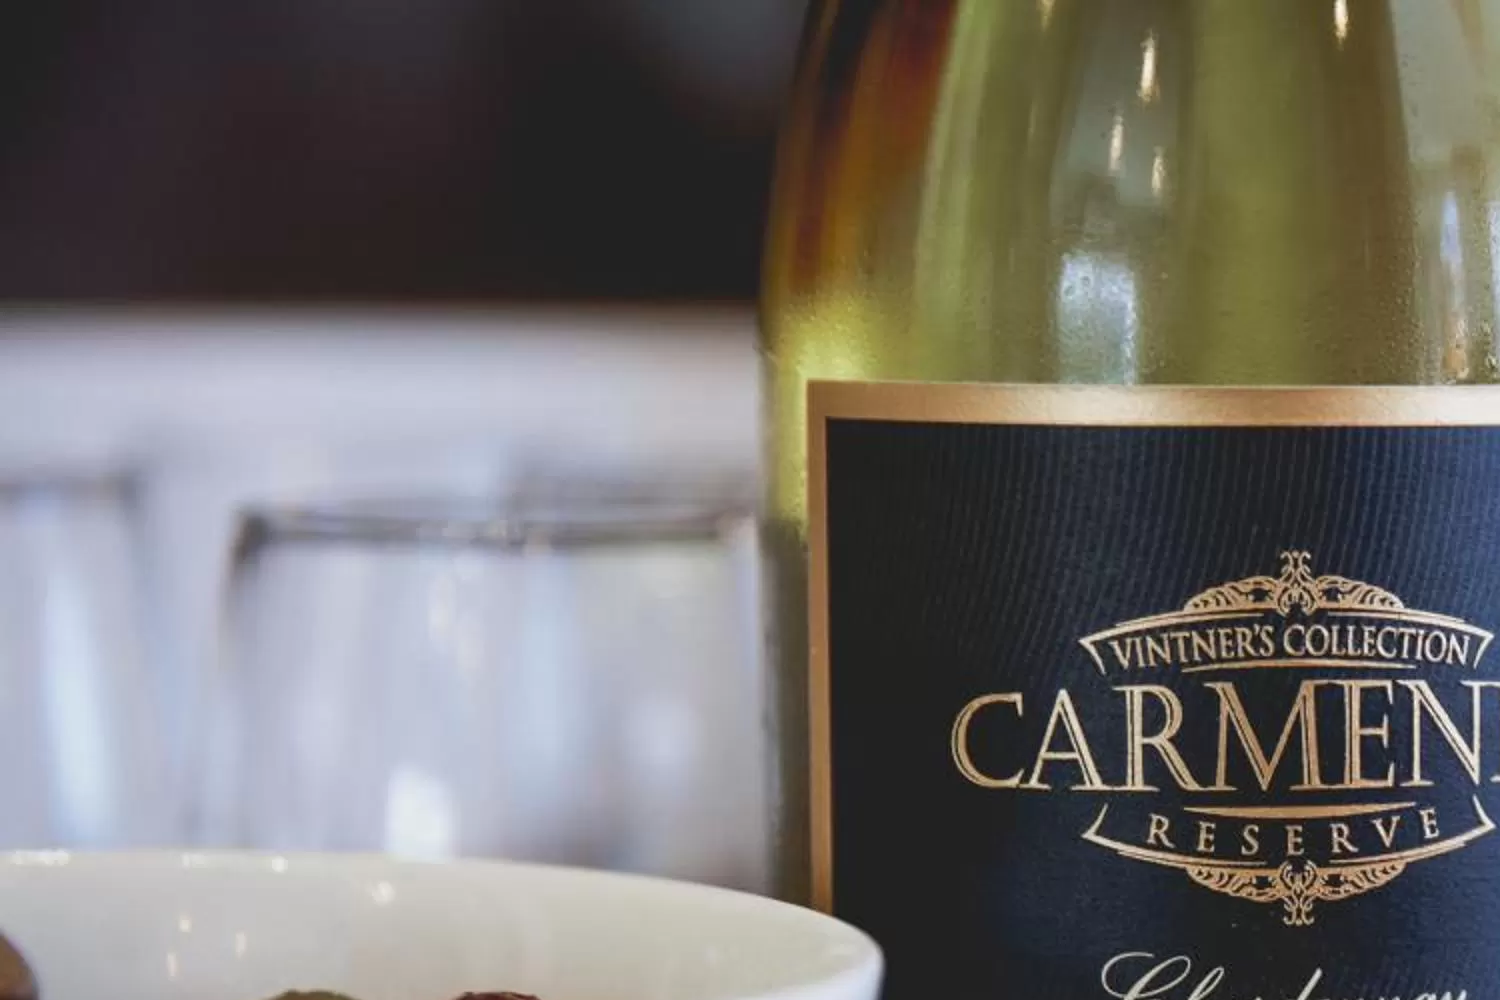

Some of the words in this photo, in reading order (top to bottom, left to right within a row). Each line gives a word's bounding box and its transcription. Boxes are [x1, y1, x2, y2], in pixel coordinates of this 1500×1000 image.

[1110, 624, 1275, 670] VINTNER'S
[1283, 624, 1472, 667] COLLECTION
[1147, 807, 1441, 857] RESERVE
